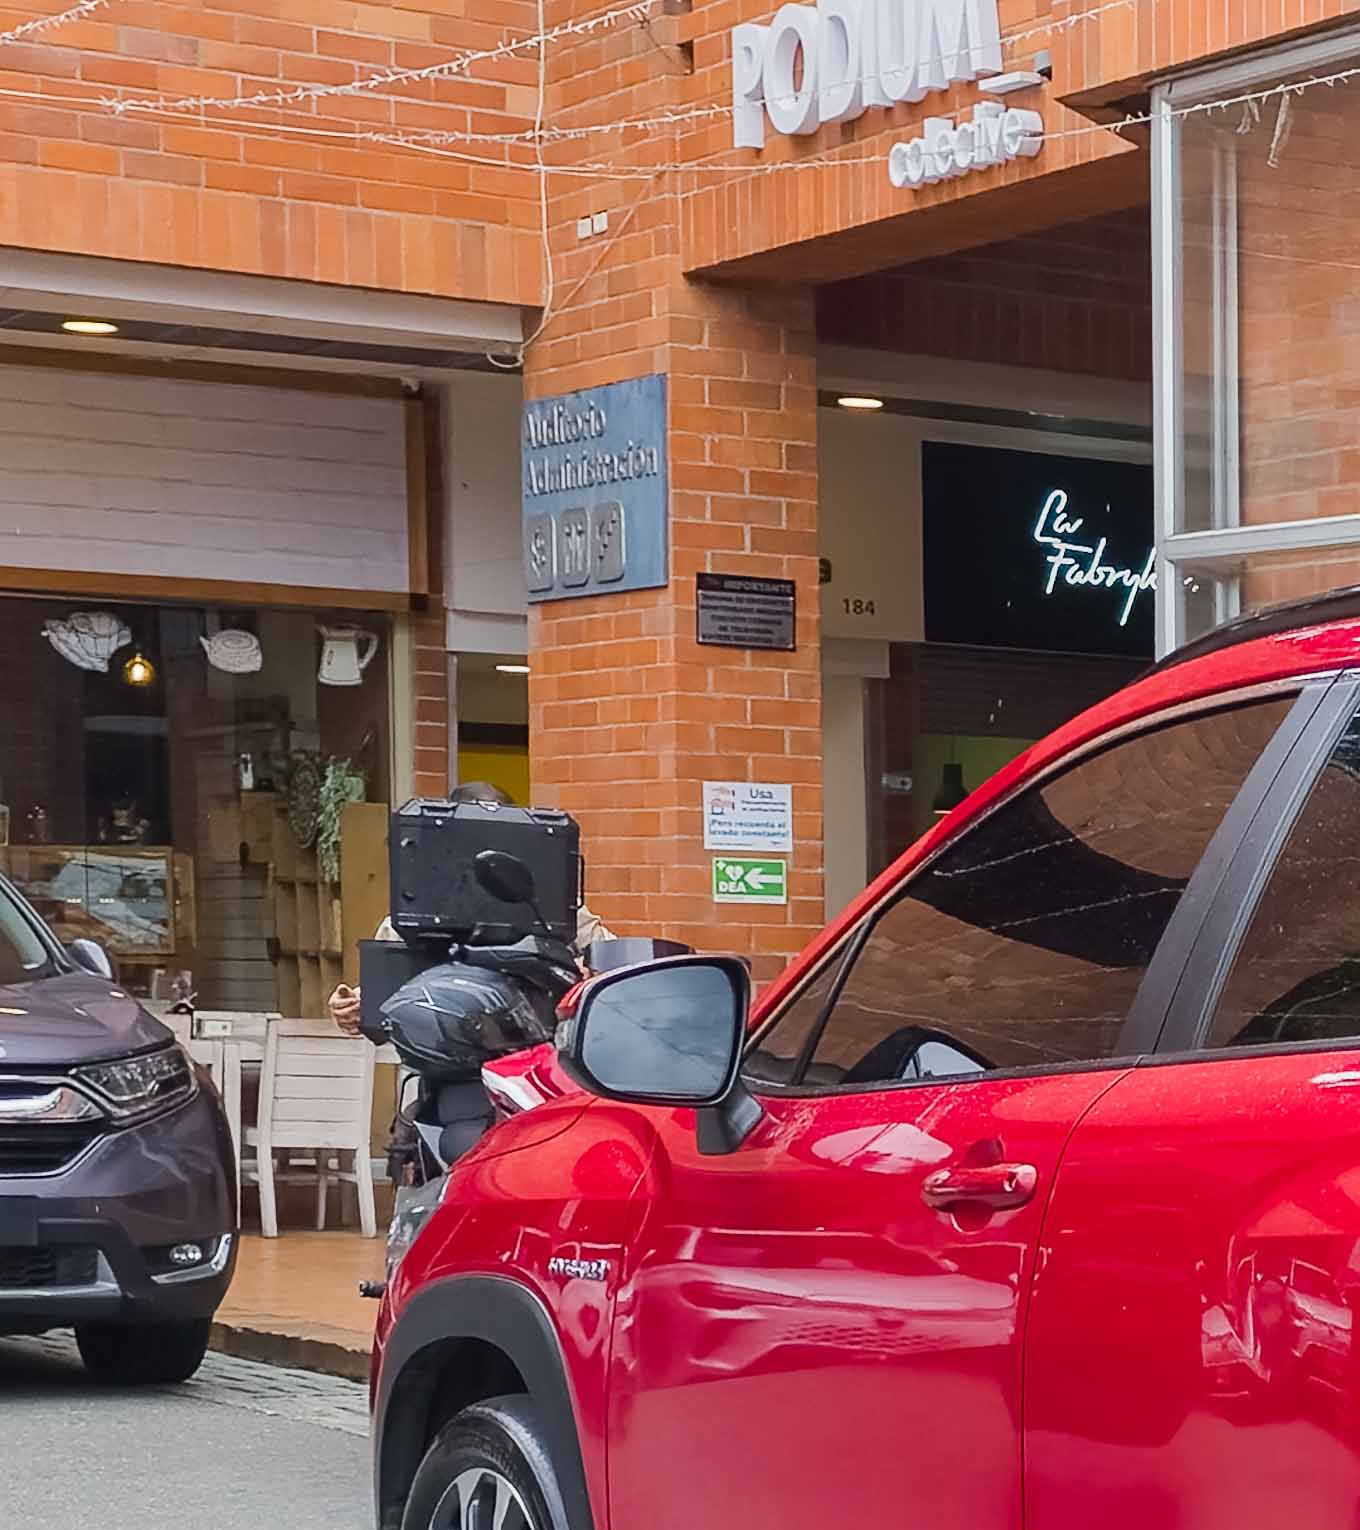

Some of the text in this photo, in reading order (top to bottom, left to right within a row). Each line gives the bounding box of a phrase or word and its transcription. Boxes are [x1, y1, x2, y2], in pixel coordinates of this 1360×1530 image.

[526, 400, 607, 448] Auditorio
[526, 440, 659, 497] Administración
[1033, 489, 1083, 543] La
[1046, 537, 1199, 626] Fabryk
[843, 599, 875, 616] 184
[750, 788, 773, 799] Usa
[718, 881, 747, 893] DEA
